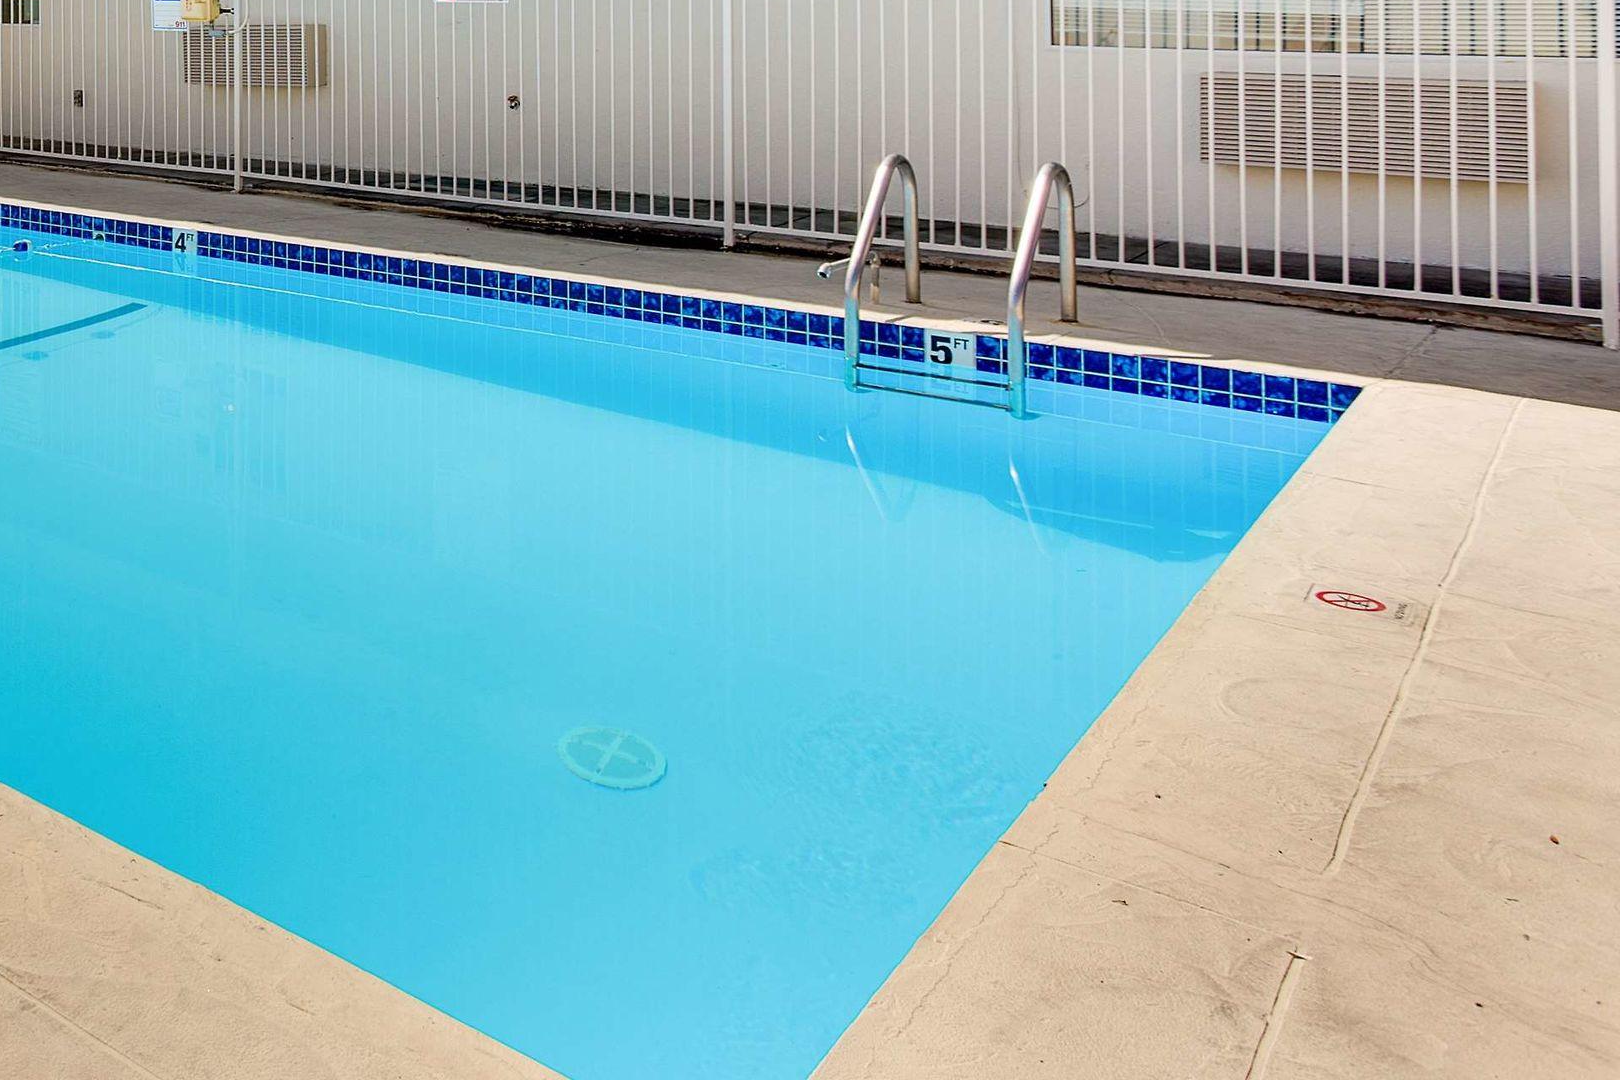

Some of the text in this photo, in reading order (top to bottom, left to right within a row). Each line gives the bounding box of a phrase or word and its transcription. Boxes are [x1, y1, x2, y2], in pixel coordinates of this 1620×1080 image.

[175, 232, 194, 252] 4 FT
[930, 335, 969, 365] 5 FT
